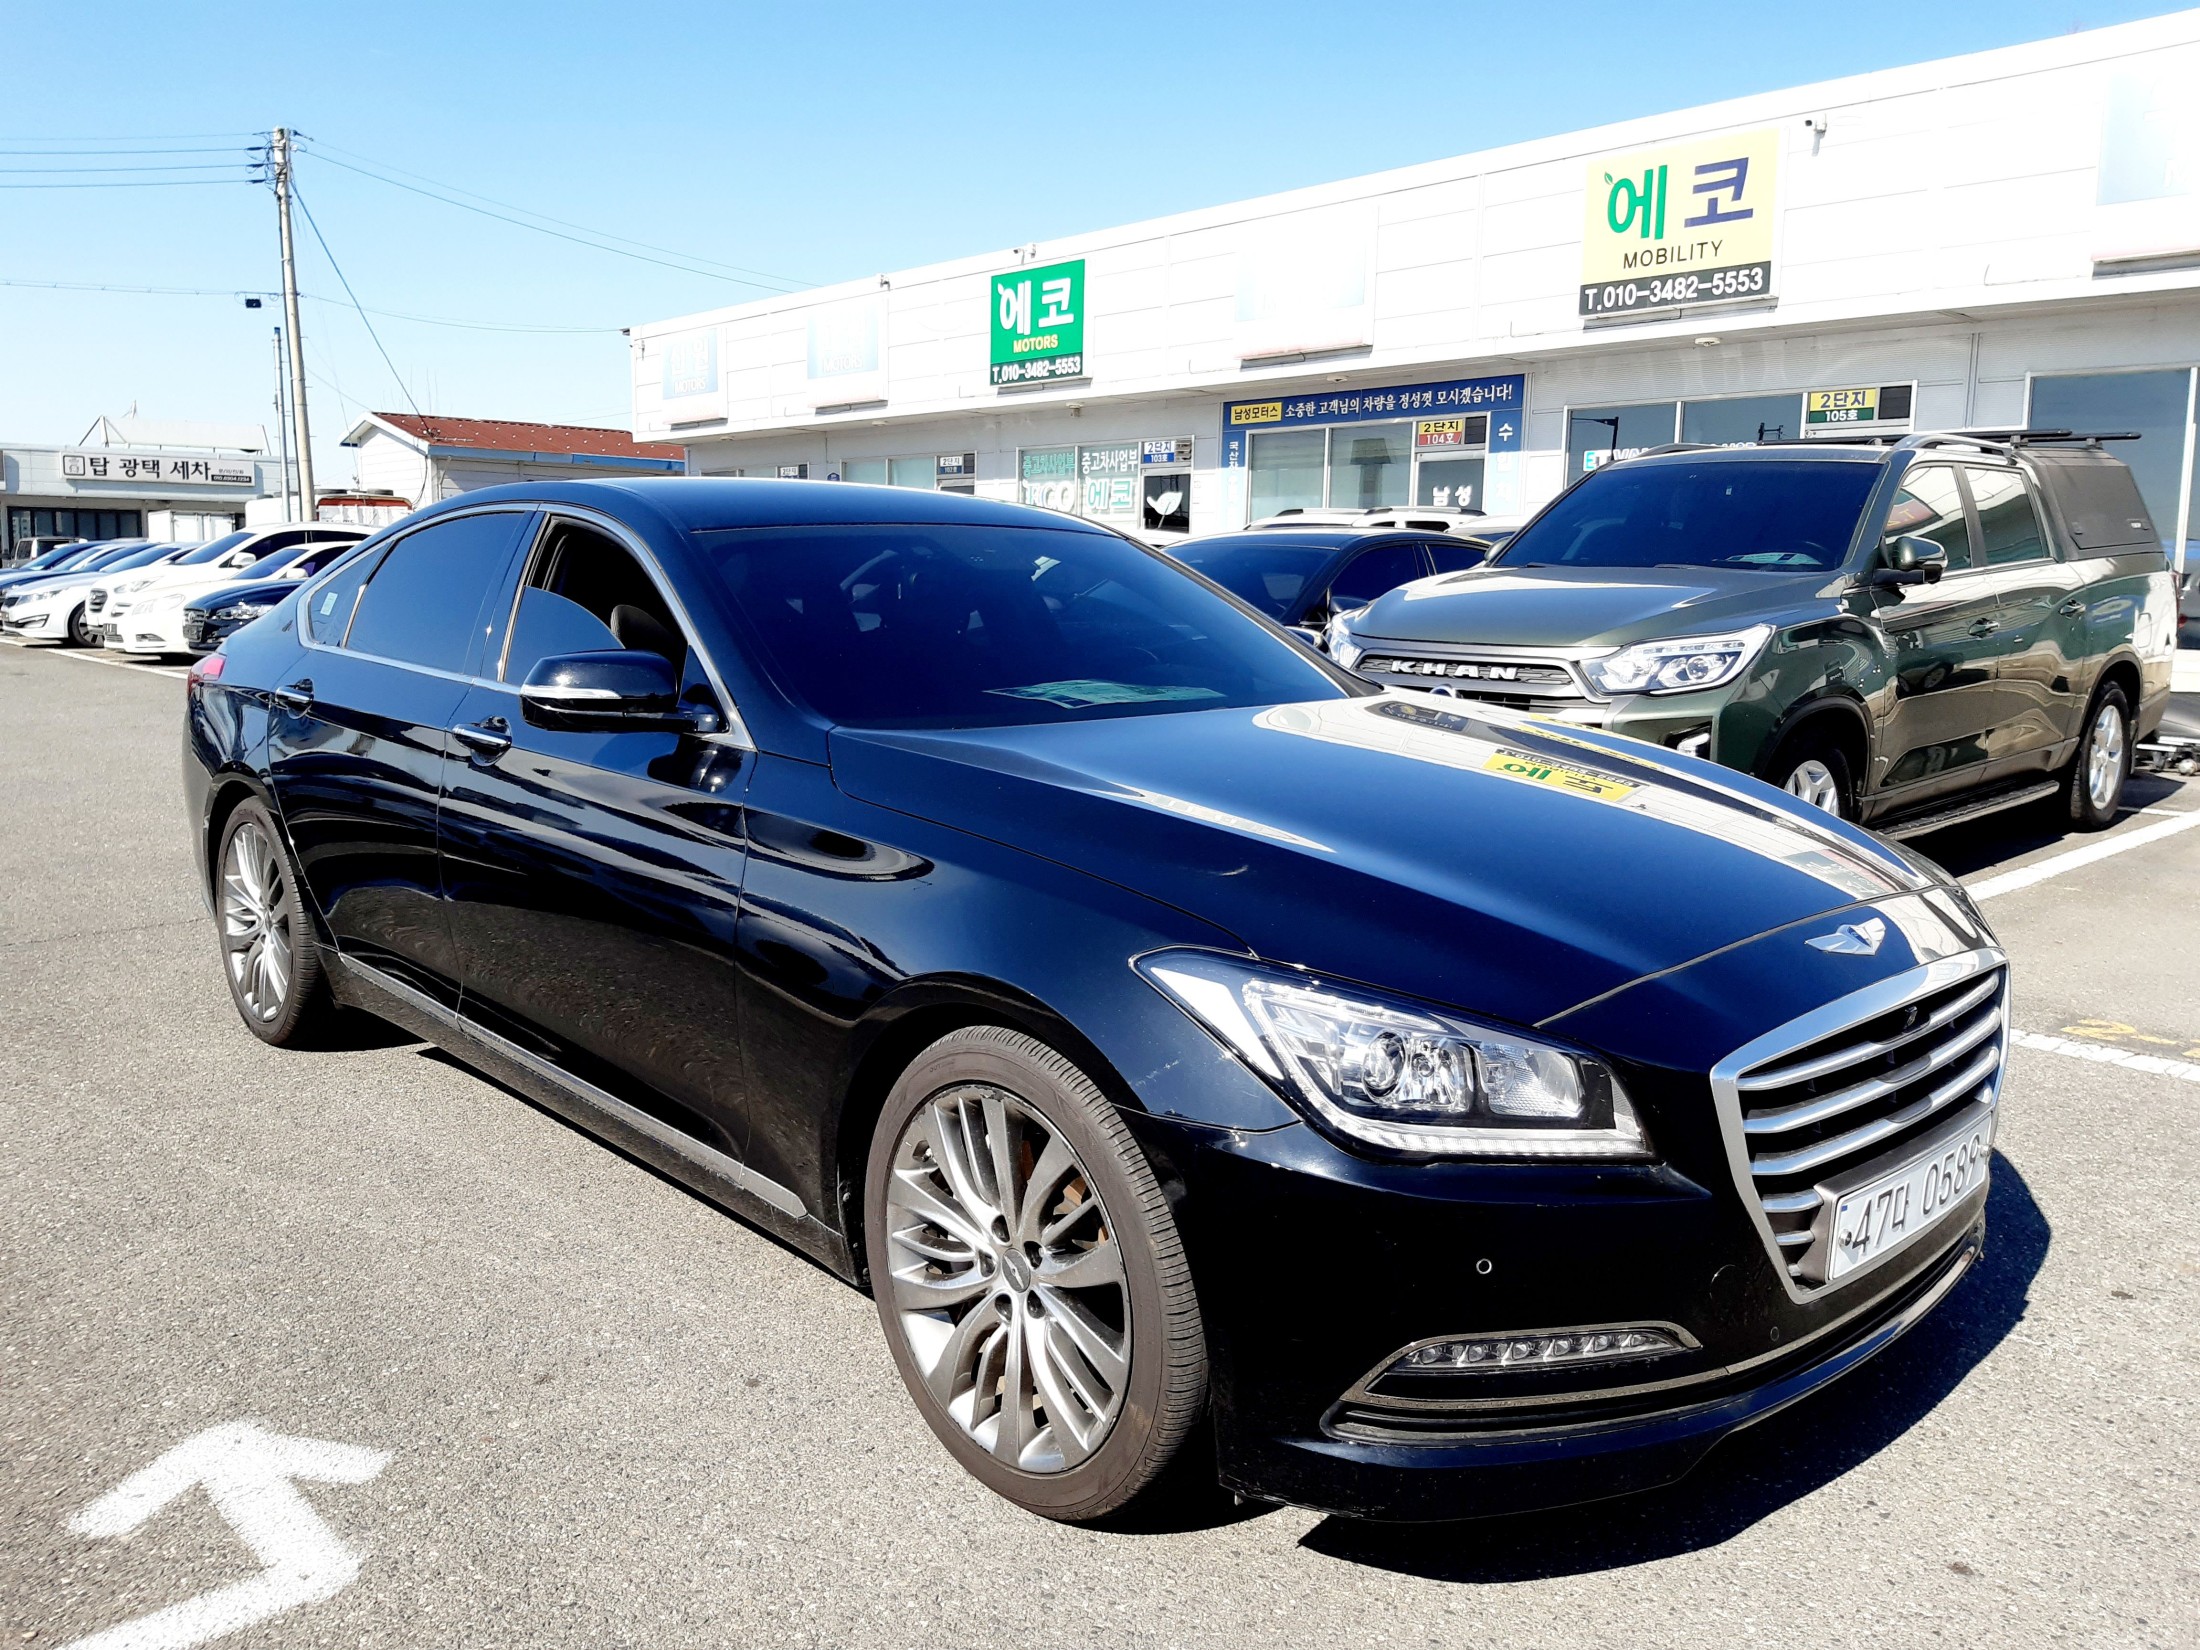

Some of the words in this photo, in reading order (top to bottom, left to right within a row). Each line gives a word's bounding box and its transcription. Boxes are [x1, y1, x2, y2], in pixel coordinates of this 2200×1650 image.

[1623, 240, 1724, 270] MOBILITY
[1013, 333, 1059, 354] MOTORS
[1234, 405, 1279, 421] 남성모터스
[1284, 403, 1317, 418] 소중한
[1318, 397, 1360, 416] 고객님의
[1362, 396, 1396, 413] 차량을
[1398, 389, 1433, 409] 정성껏
[1435, 383, 1513, 407] 모시겠습니다!
[1820, 390, 1867, 408] 2단지
[1825, 409, 1858, 422] 105호
[1424, 421, 1459, 433] 2단지
[1147, 441, 1173, 453] 2단지
[1426, 433, 1454, 445] 104호
[89, 456, 110, 476] 탑
[119, 458, 160, 479] 광택
[170, 460, 211, 481] 세차
[1081, 449, 1138, 475] 중고차사업부
[1150, 453, 1168, 463] 103호
[1390, 659, 1518, 680] KHAN
[1920, 1132, 1981, 1215] 0589
